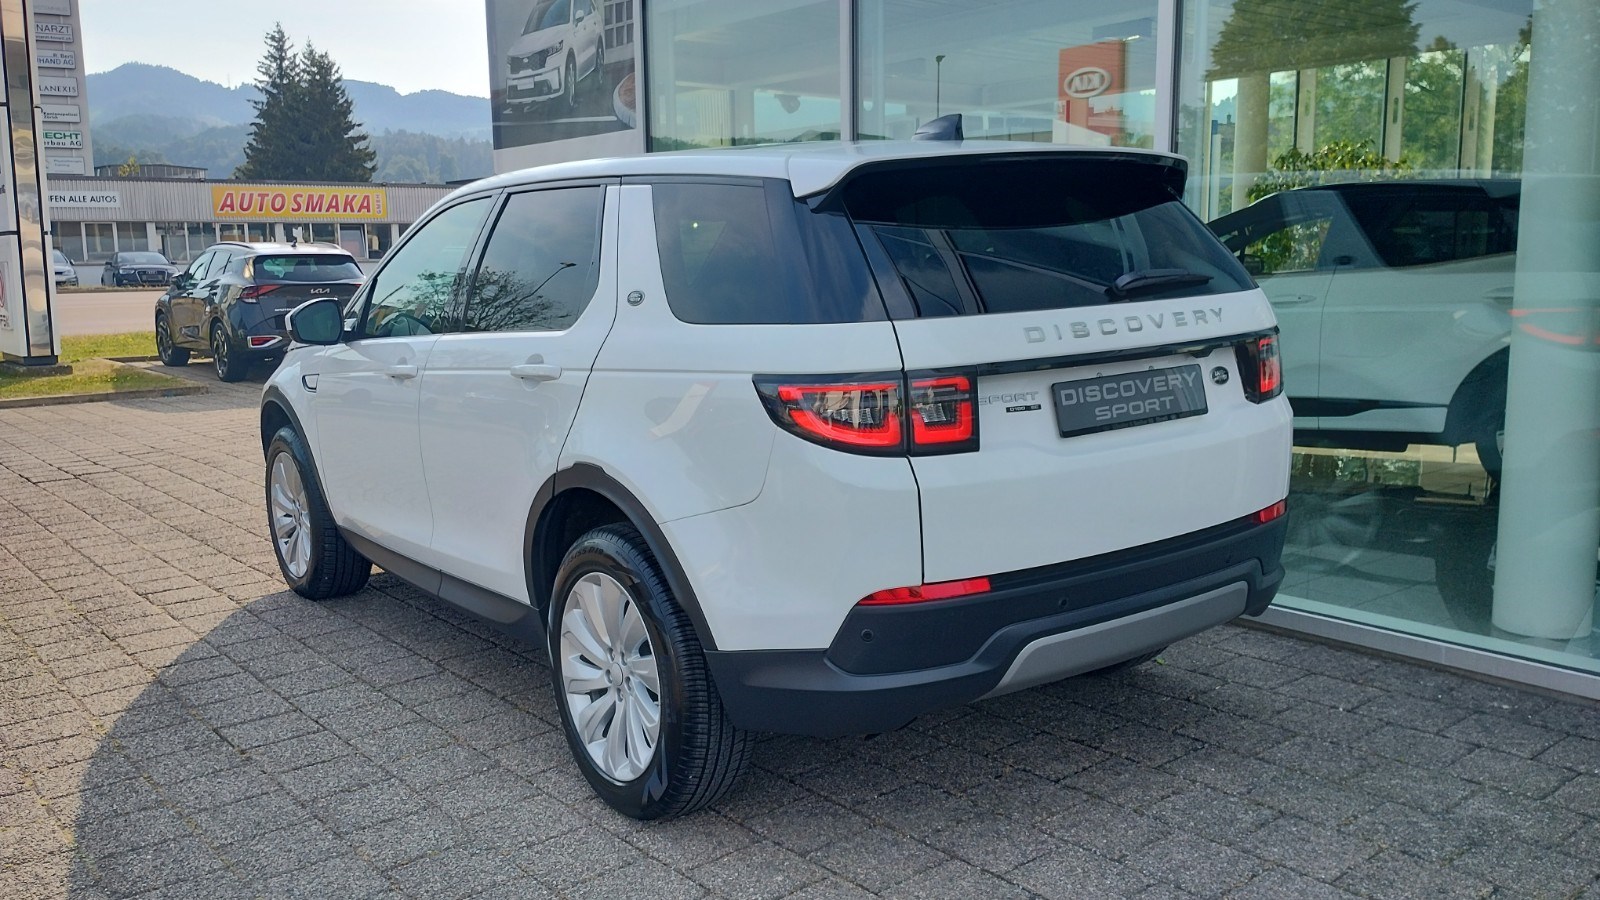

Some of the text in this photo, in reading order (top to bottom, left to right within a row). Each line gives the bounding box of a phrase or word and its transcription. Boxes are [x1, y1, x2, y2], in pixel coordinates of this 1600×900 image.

[69, 195, 87, 203] ALLE
[90, 195, 117, 203] AUTOS
[219, 192, 371, 213] AUTO SMAKA
[1023, 307, 1222, 344] DISCOVERY
[1060, 371, 1197, 406] DISCOVERY
[1094, 396, 1175, 421] SPORT
